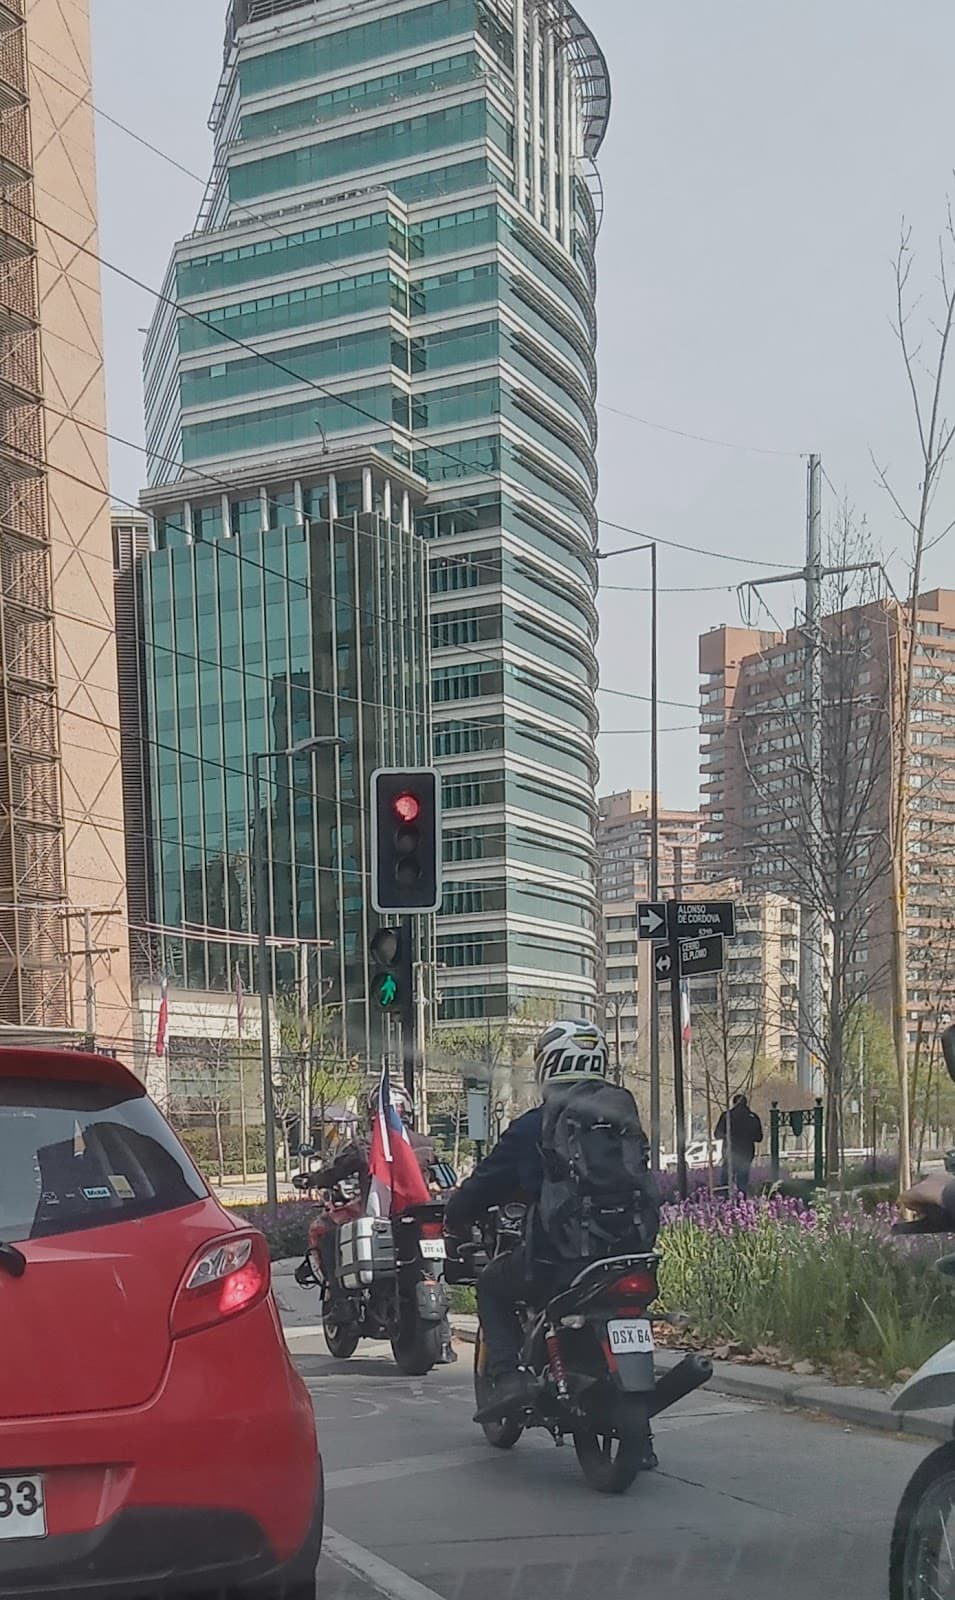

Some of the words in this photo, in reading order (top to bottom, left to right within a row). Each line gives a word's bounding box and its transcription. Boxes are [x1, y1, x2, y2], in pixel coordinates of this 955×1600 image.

[678, 905, 706, 914] ALONSO
[678, 914, 687, 924] DE
[687, 914, 720, 924] CORDOVA
[612, 1329, 634, 1345] DSX
[637, 1329, 651, 1344] 64
